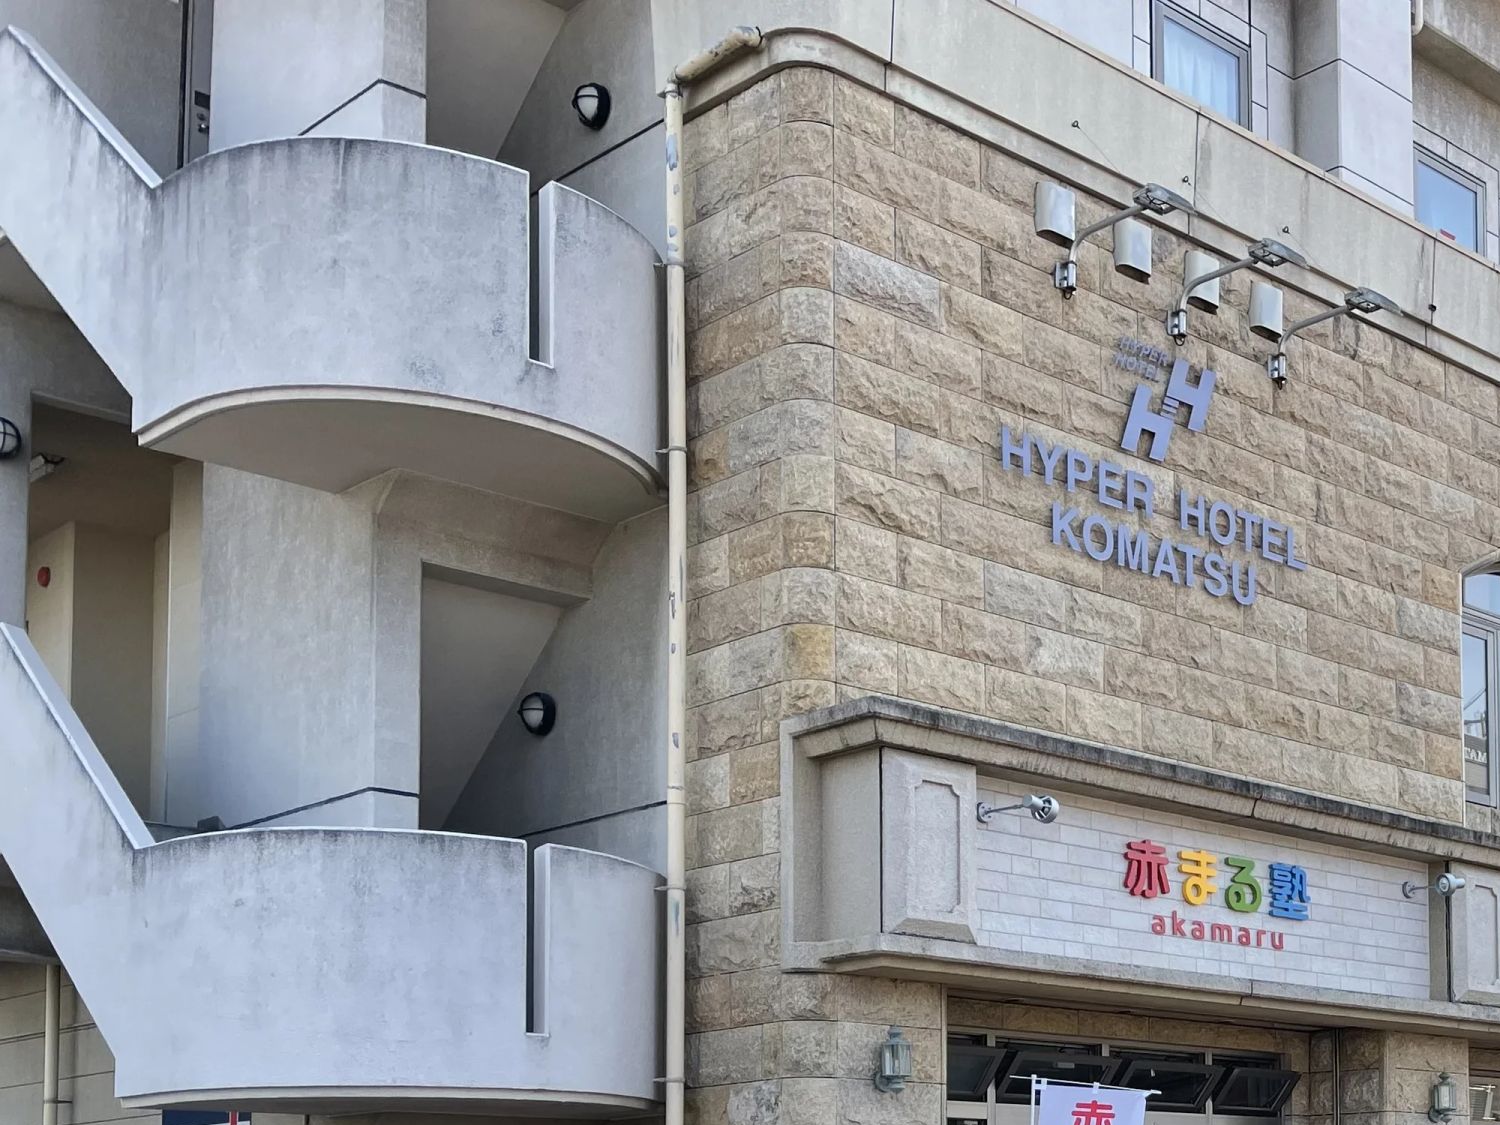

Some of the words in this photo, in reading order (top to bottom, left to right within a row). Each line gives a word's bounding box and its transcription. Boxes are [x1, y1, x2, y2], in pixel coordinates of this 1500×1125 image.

[1114, 352, 1160, 381] HOTEL
[1119, 335, 1168, 367] HYPER
[1000, 426, 1155, 518] HYPER
[1179, 489, 1307, 571] HOTEL
[1050, 502, 1258, 606] KOMATSU
[1124, 839, 1311, 922] 赤まる塾
[1151, 910, 1286, 950] akamaru
